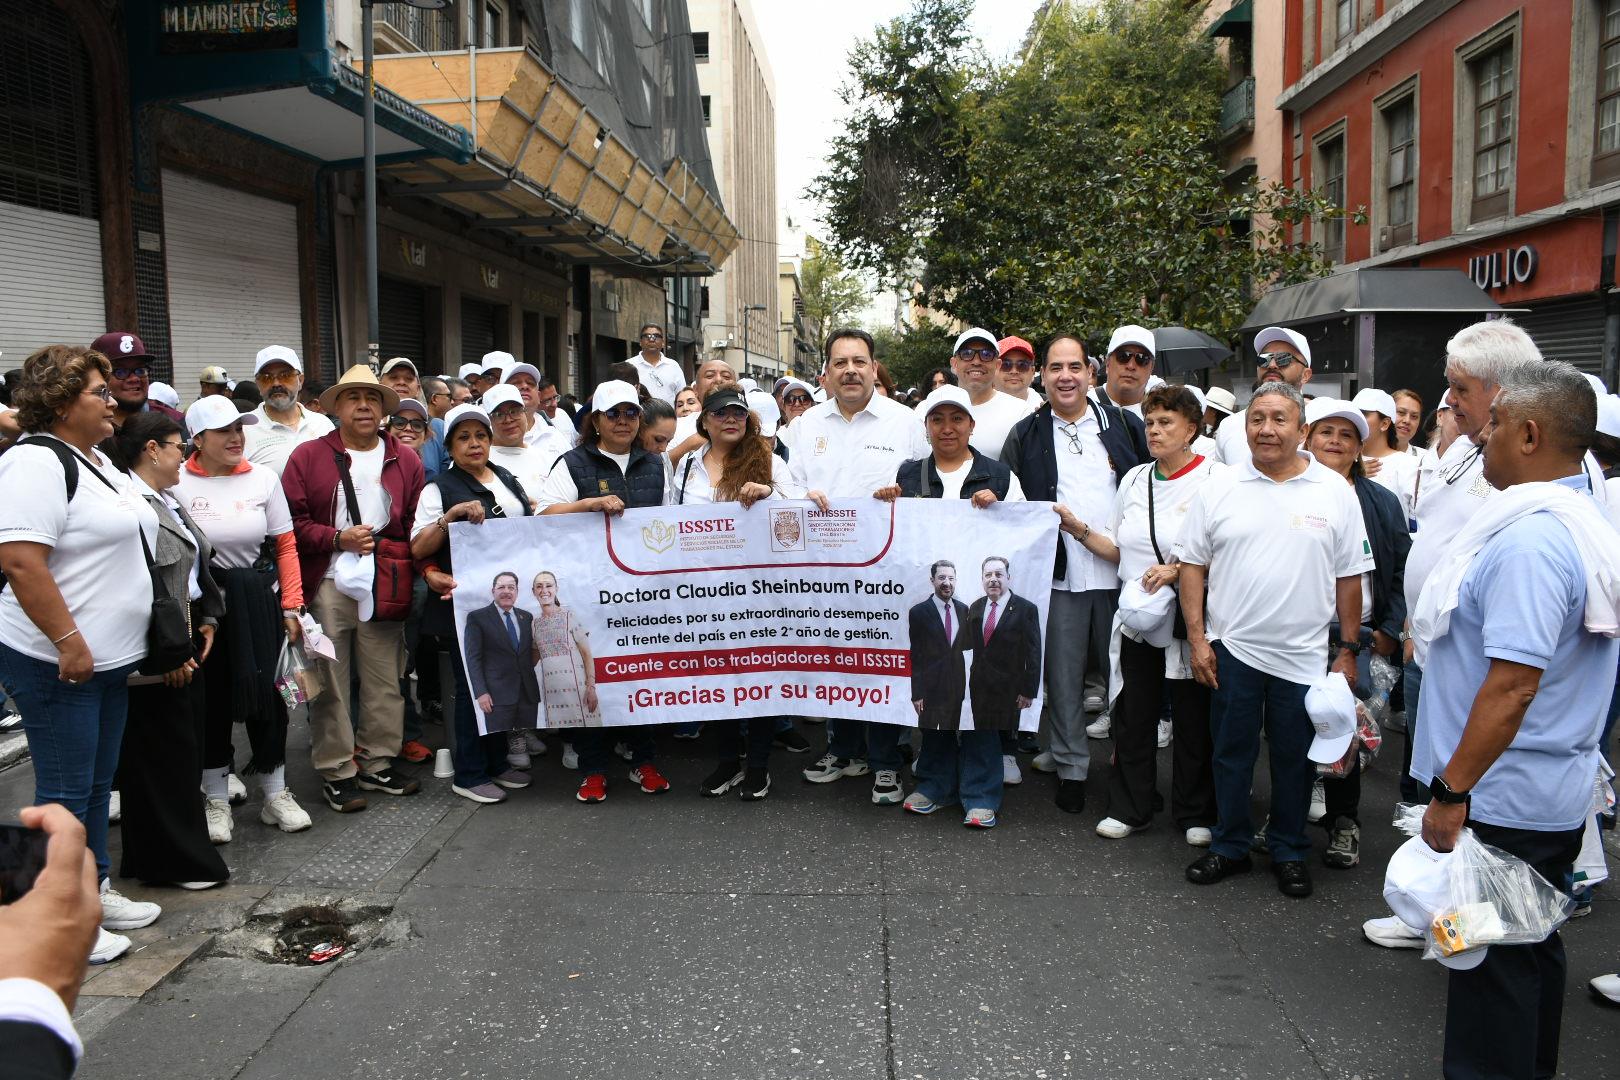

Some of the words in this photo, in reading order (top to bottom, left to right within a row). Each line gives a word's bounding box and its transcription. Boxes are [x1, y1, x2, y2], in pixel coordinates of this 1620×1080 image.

[411, 241, 426, 268] taf
[1468, 245, 1537, 290] JULIO
[678, 518, 735, 534] ISSSTE
[599, 588, 671, 605] Doctora
[676, 581, 746, 599] Claudia
[752, 578, 850, 595] Sheinbaum
[854, 579, 905, 595] Pardo
[607, 613, 683, 629] Felicidades
[686, 614, 708, 625] por
[711, 613, 725, 622] su
[729, 607, 820, 621] extraordinario
[823, 607, 900, 622] desempeño
[616, 635, 629, 647] al
[632, 633, 671, 645] frente
[674, 632, 695, 643] del
[698, 629, 726, 644] país
[729, 630, 746, 640] en
[750, 627, 777, 638] este
[796, 626, 821, 638] año
[824, 627, 841, 638] de
[844, 628, 893, 641] gestión.
[605, 658, 664, 675] Cuente
[668, 657, 699, 670] con
[703, 655, 726, 668] los
[729, 650, 831, 667] trabajadores
[834, 652, 858, 666] del
[862, 653, 906, 669] ISSSTE
[628, 685, 726, 713] ¡Gracias
[733, 684, 773, 706] por
[780, 684, 808, 699] su
[815, 684, 890, 707] apoyo!
